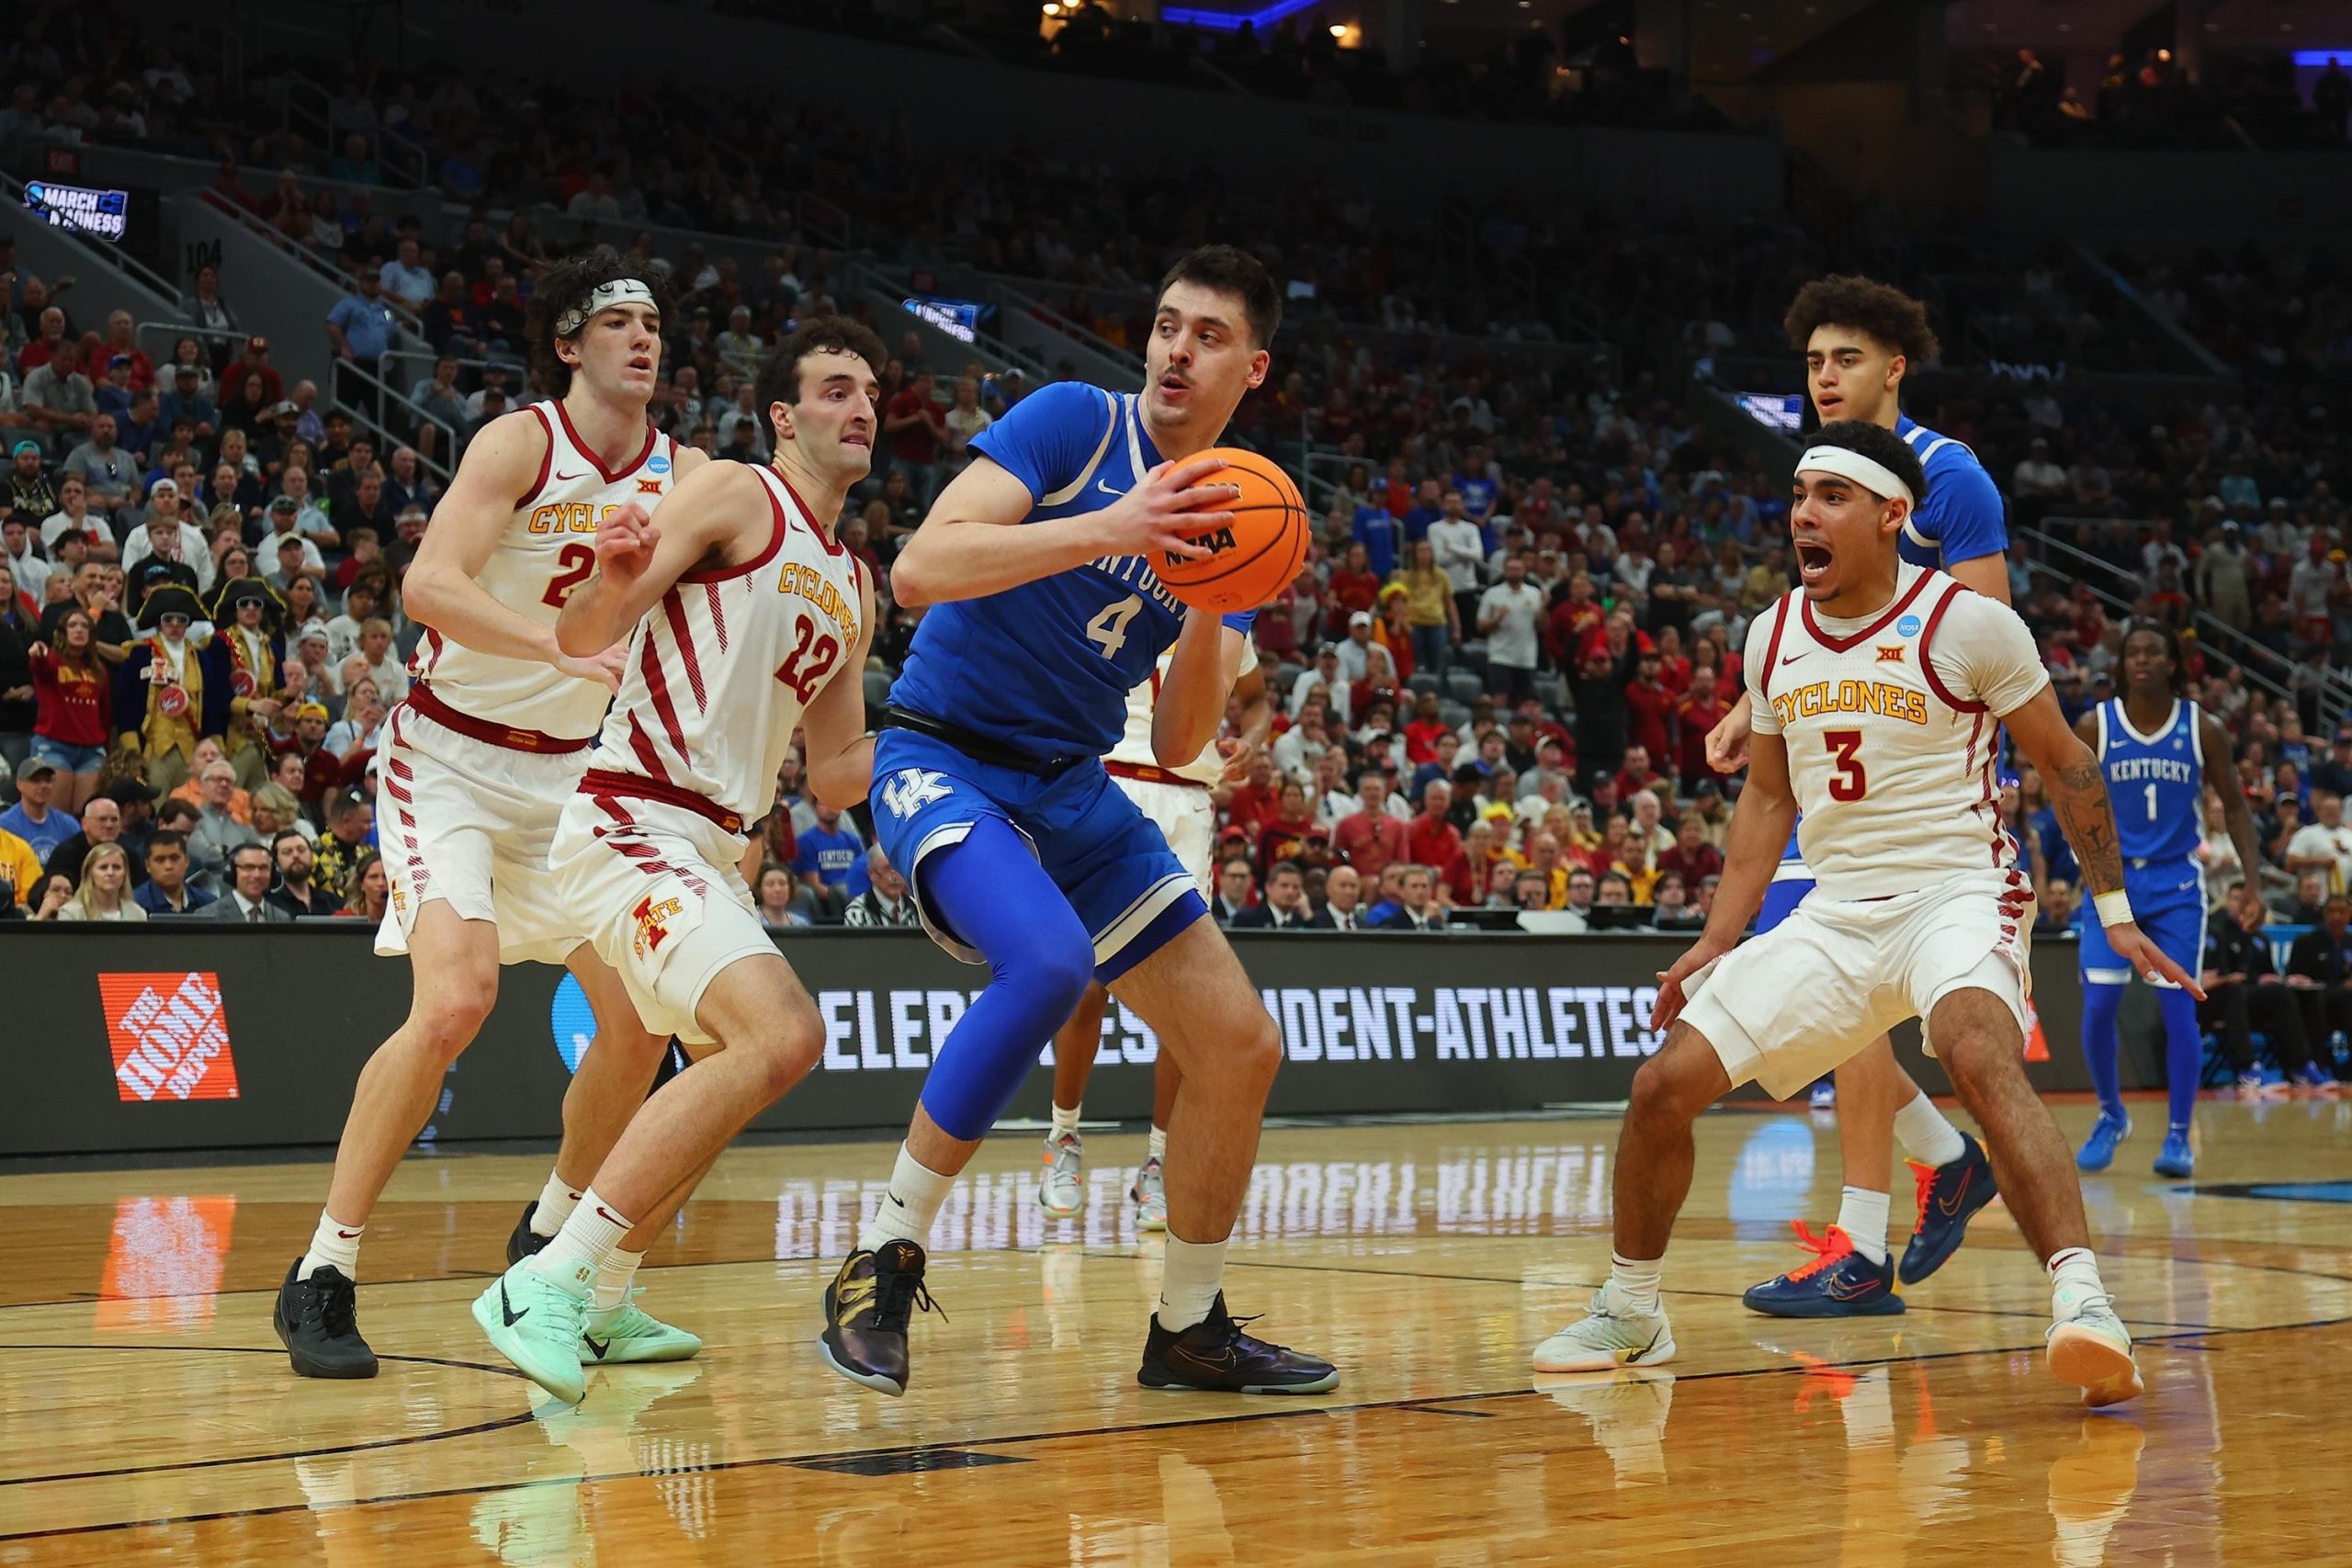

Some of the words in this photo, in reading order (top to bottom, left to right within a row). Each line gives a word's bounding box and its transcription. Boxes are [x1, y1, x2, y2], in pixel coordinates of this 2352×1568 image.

[43, 187, 98, 211] MARCH
[187, 238, 222, 273] 104
[541, 543, 595, 609] 2
[1086, 592, 1143, 660] 4
[774, 614, 839, 706] 22
[1772, 680, 1928, 728] CYCLONES
[1823, 729, 1867, 802] 3
[2109, 757, 2191, 784] KENTUCKY
[2143, 782, 2158, 821] 1
[634, 897, 684, 963] STATE
[116, 972, 222, 1101] HOME
[119, 986, 165, 1038] THE
[166, 1019, 230, 1100] DEPOT
